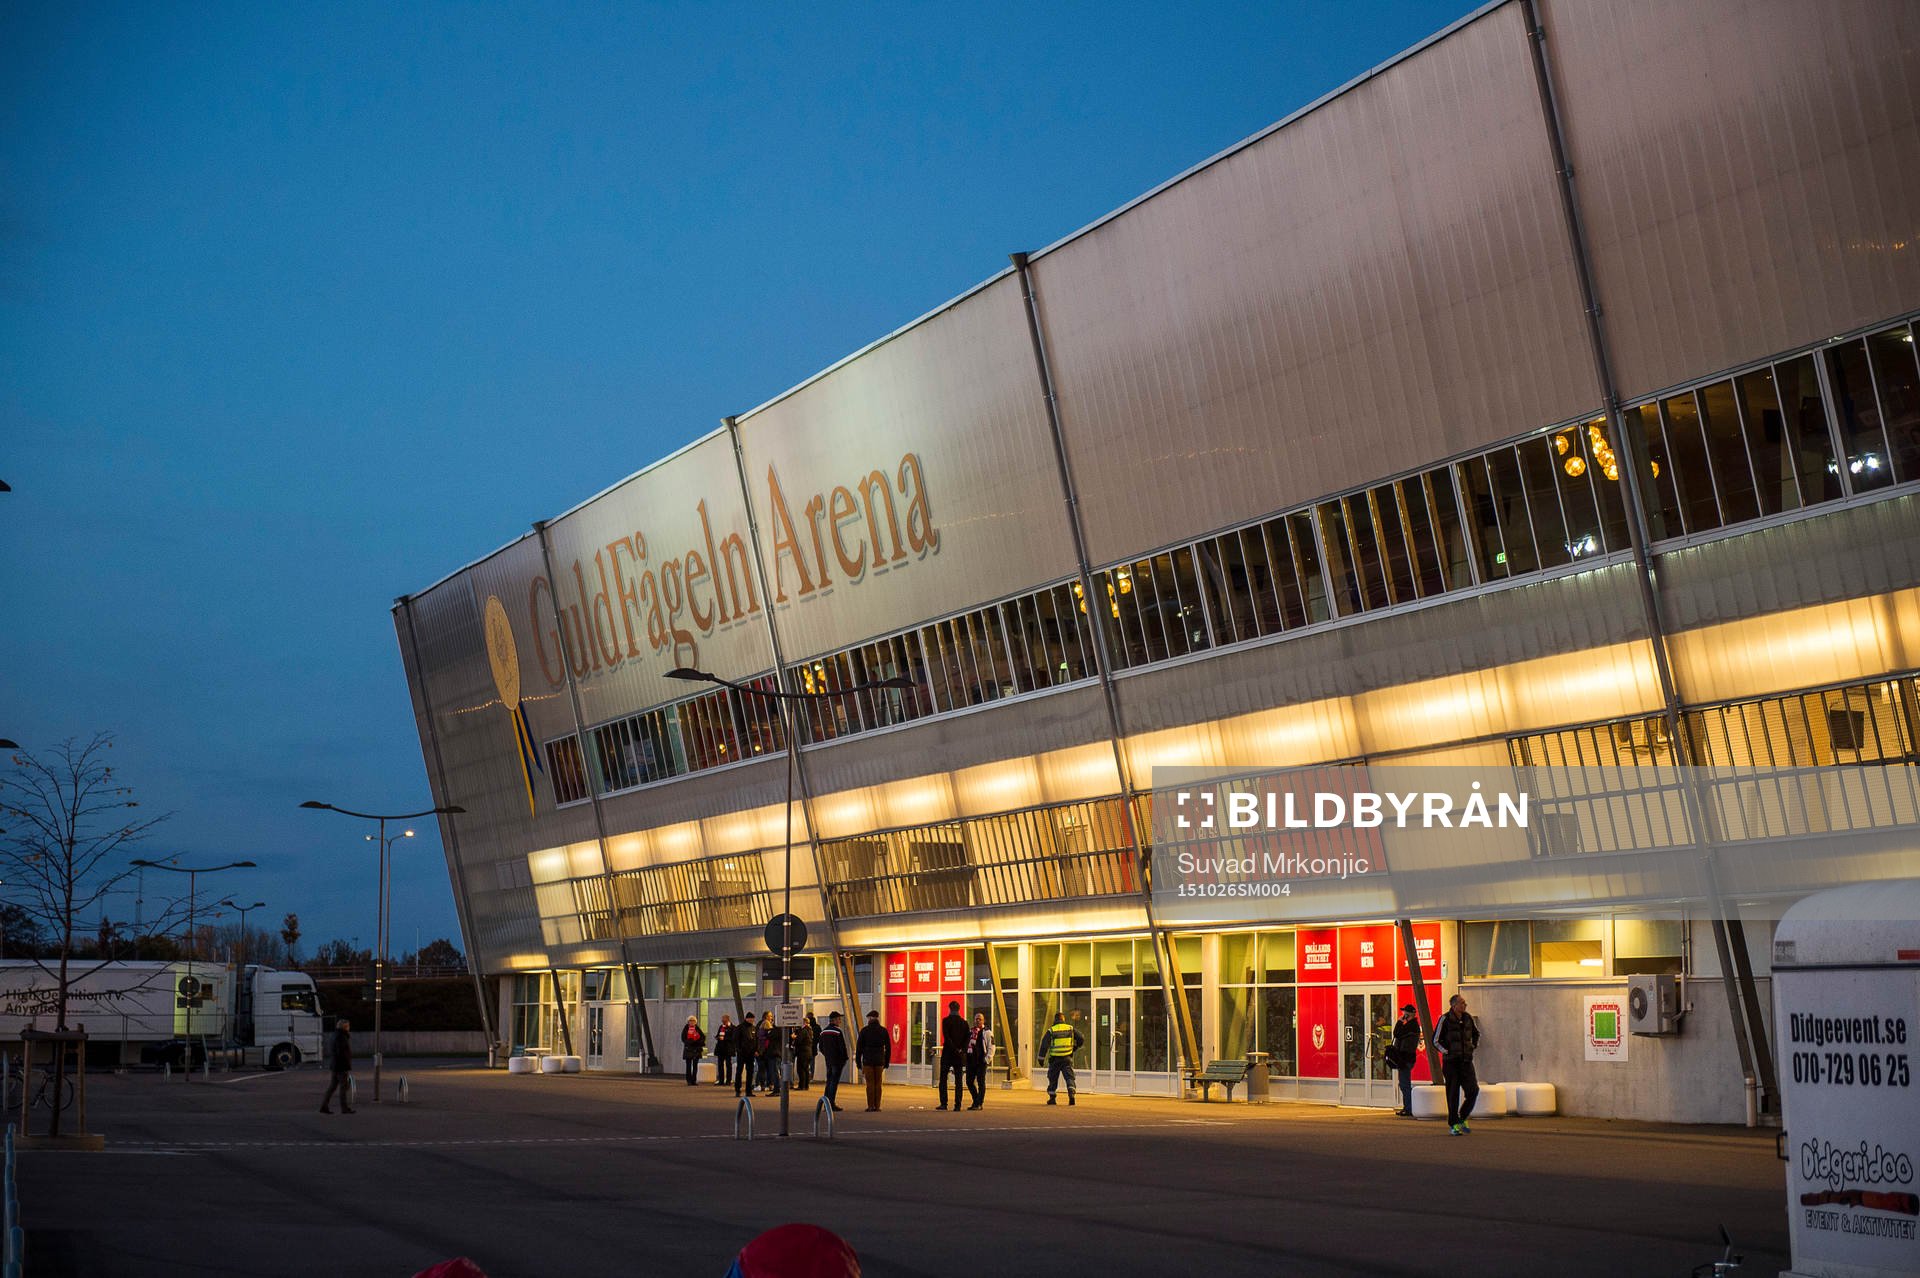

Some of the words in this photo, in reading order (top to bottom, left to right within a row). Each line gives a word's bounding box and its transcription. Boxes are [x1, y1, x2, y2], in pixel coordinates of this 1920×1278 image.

[530, 498, 761, 686] GuldFågeln
[767, 452, 939, 603] Arena
[1791, 1013, 1906, 1047] Didgeevent.se
[1793, 1052, 1854, 1086] 070-729
[1858, 1053, 1882, 1086] 06
[1886, 1054, 1910, 1087] 25
[1801, 1137, 1913, 1192] Didgeridoo
[1805, 1209, 1839, 1231] EVENT
[1841, 1213, 1851, 1232] &
[1852, 1214, 1916, 1240] AKTIVITET
